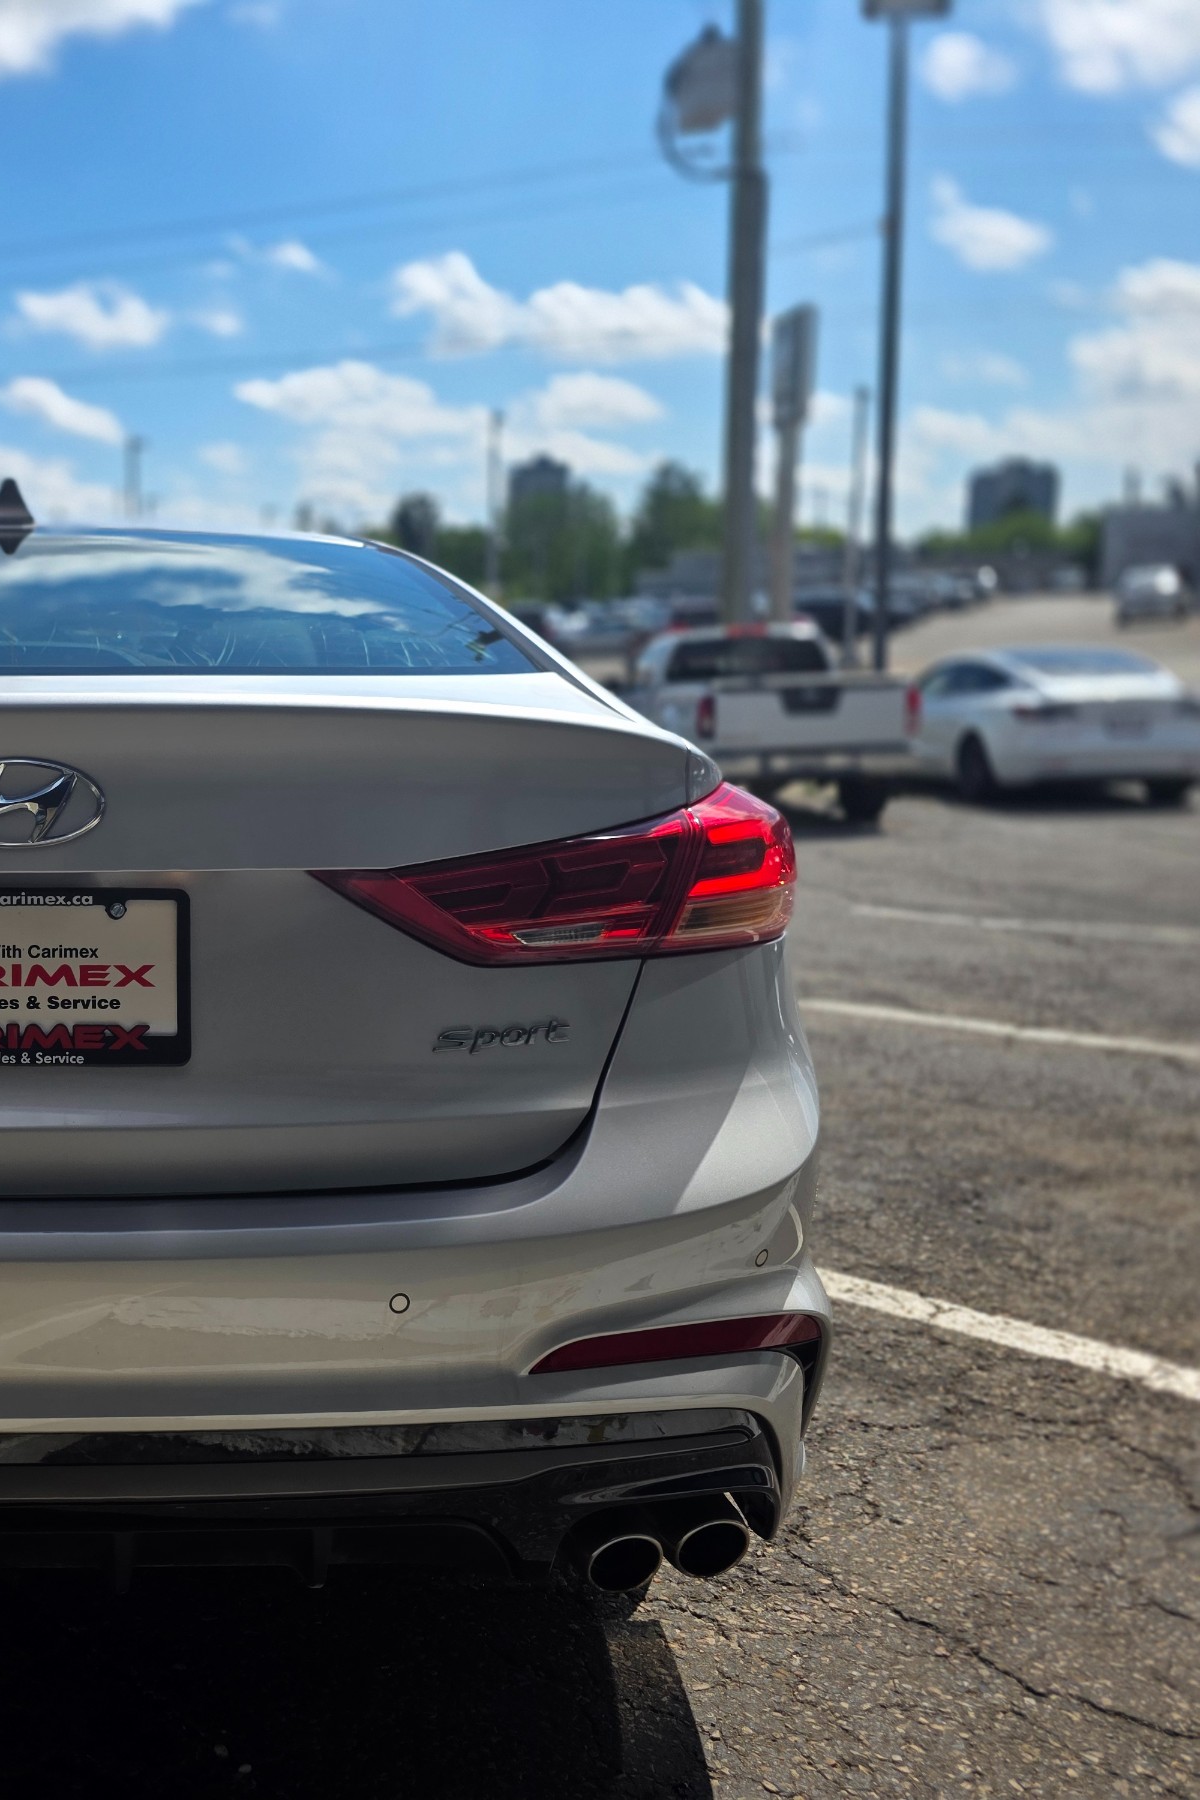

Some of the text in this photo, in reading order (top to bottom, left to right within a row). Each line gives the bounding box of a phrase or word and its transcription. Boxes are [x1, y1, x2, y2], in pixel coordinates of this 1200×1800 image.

[27, 944, 99, 960] Carimex
[26, 996, 41, 1010] &
[47, 996, 121, 1010] Service
[20, 1052, 31, 1065] &
[35, 1051, 85, 1065] Service
